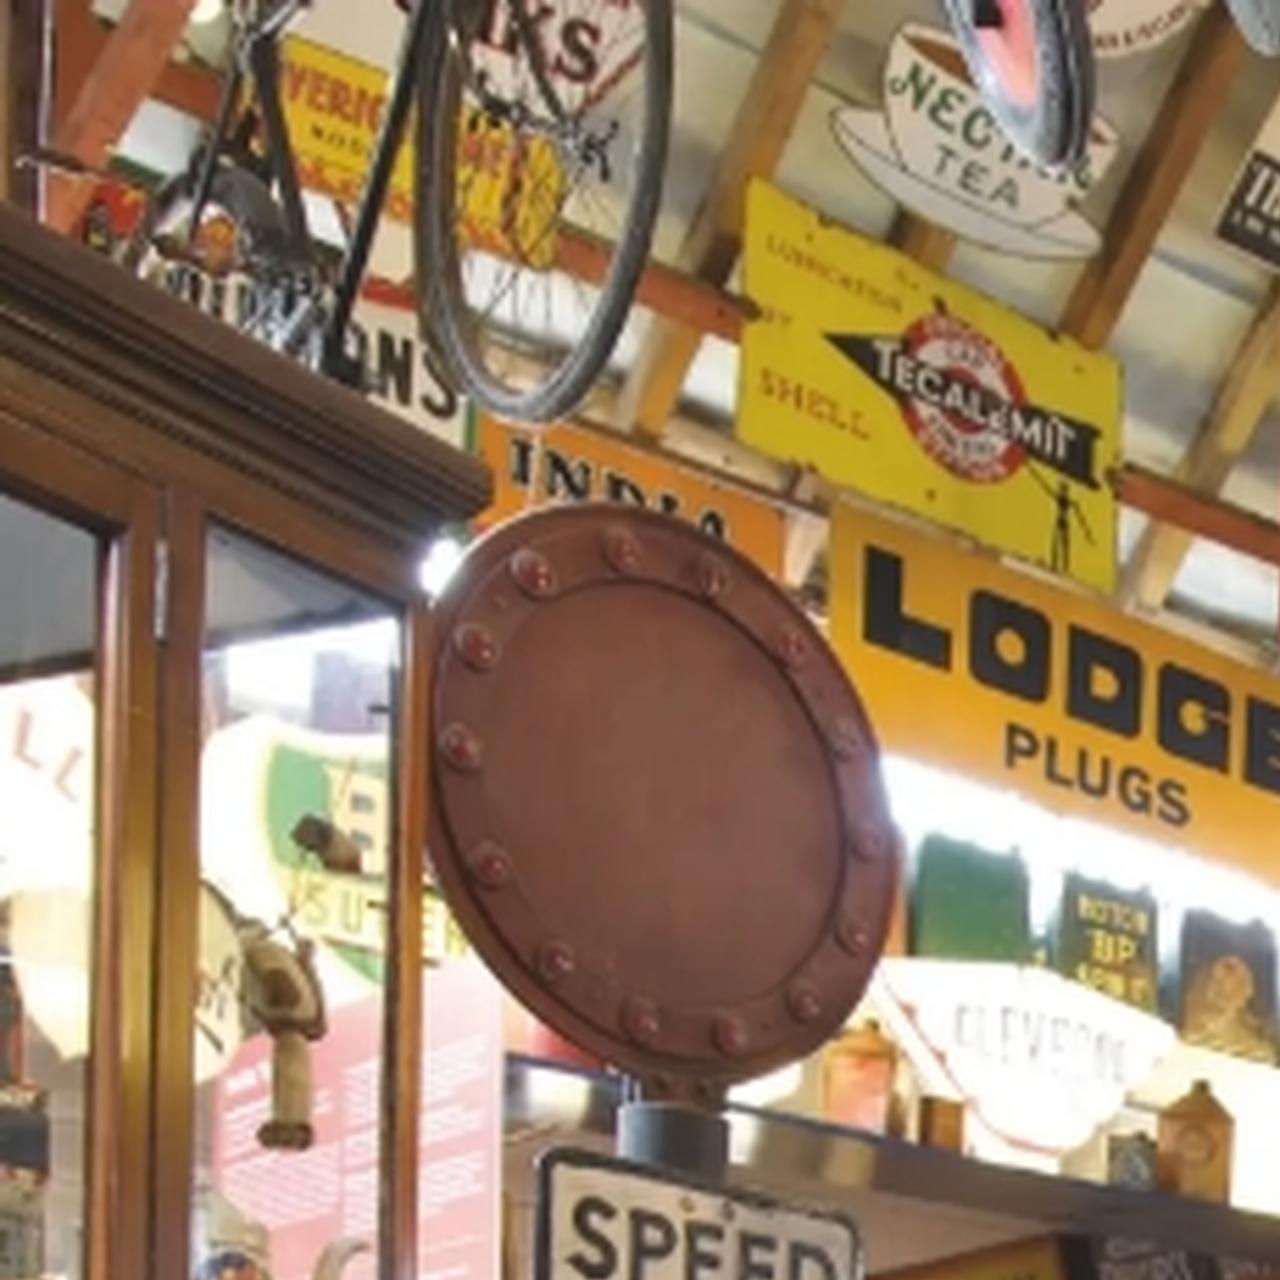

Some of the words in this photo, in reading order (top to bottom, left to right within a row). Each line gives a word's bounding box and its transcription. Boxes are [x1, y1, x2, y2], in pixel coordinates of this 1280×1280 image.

[933, 144, 1020, 207] TEA
[759, 366, 870, 441] SHELL
[872, 340, 1076, 459] TECALEMIT
[1004, 724, 1191, 830] PLUGS
